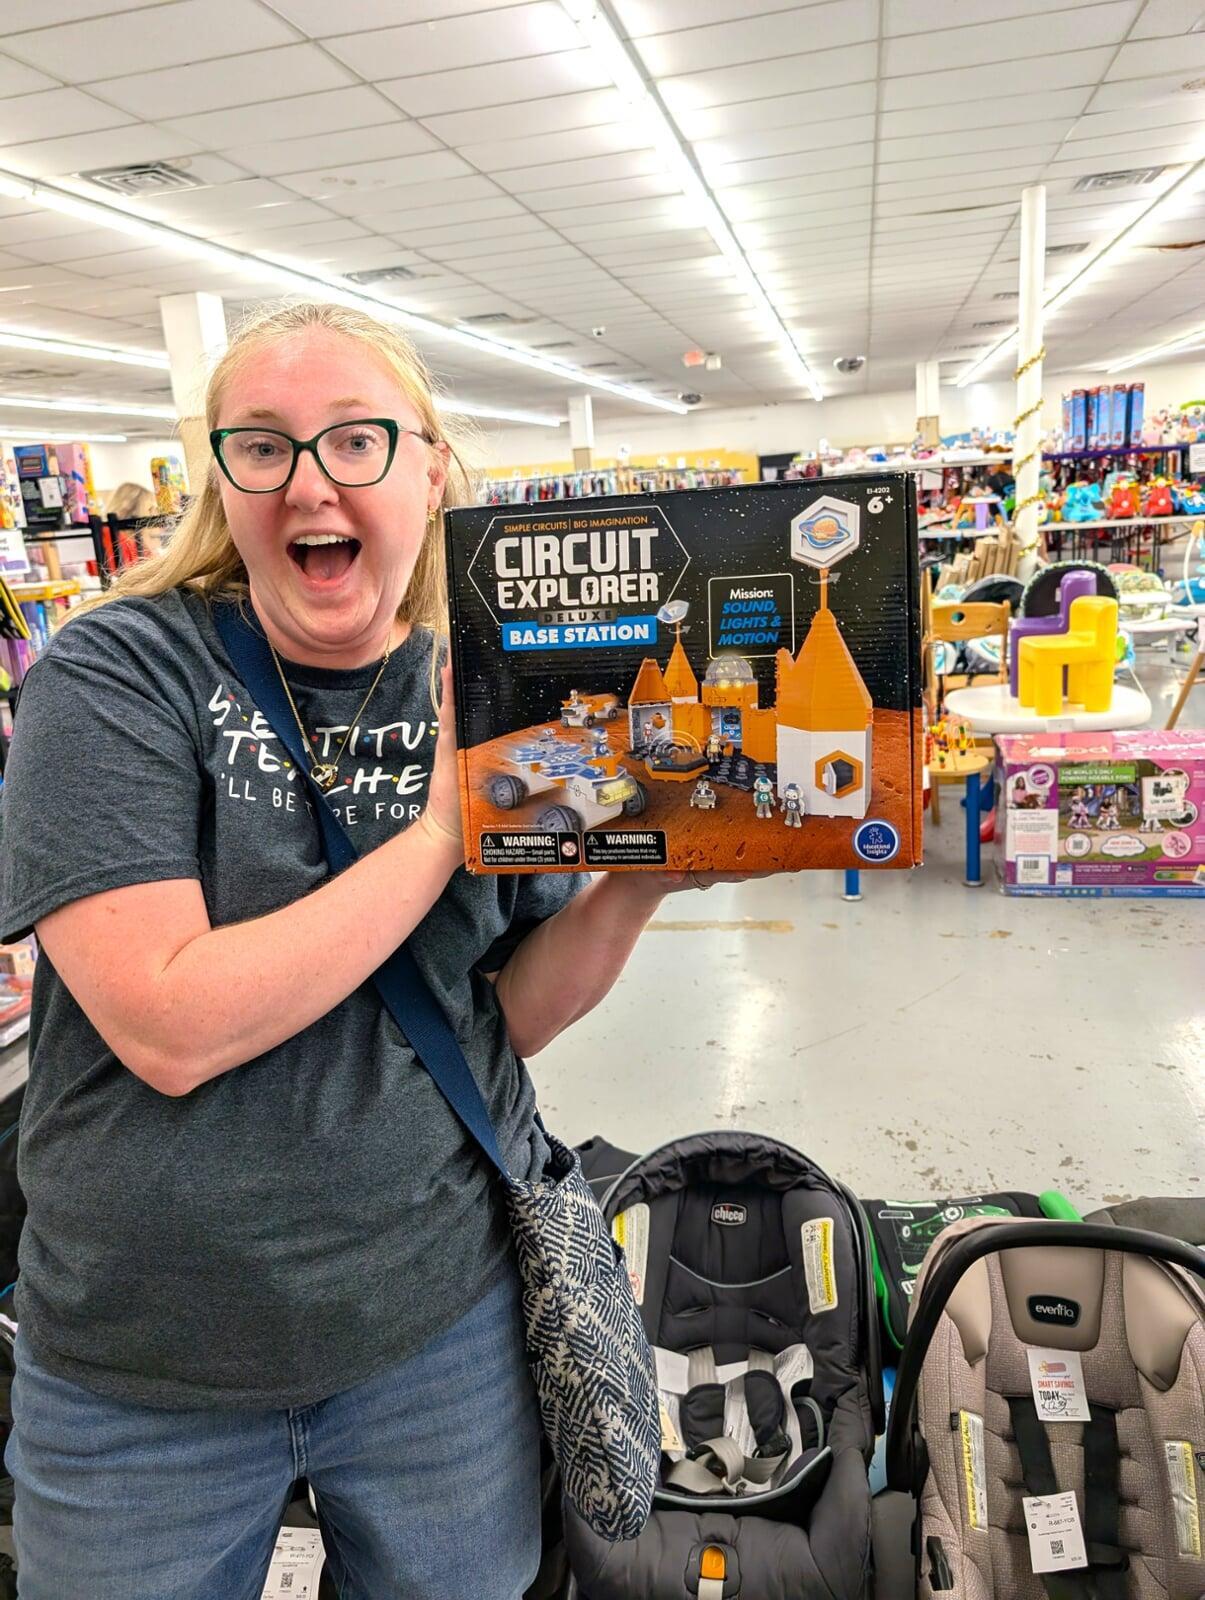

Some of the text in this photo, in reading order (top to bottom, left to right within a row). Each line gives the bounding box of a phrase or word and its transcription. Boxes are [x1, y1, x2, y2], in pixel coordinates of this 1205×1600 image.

[866, 487, 890, 495] EI-4202
[867, 495, 894, 514] 6+
[504, 516, 648, 534] SIMPLE CIRCUITS BIG IMAGINATION
[494, 528, 659, 578] CIRCUIT
[497, 572, 659, 610] EXPLORER
[729, 587, 774, 600] Mission:
[722, 600, 777, 614] SOUND,
[544, 610, 612, 623] DELUXE
[720, 616, 782, 630] LIGHTS &
[509, 624, 649, 646] BASE STATION
[717, 632, 779, 646] MOTION
[272, 787, 296, 812] BE
[502, 835, 556, 847] WARNING:
[605, 834, 657, 845] WARNING:
[714, 1205, 744, 1221] chicco
[1038, 1390, 1060, 1401] TODAY
